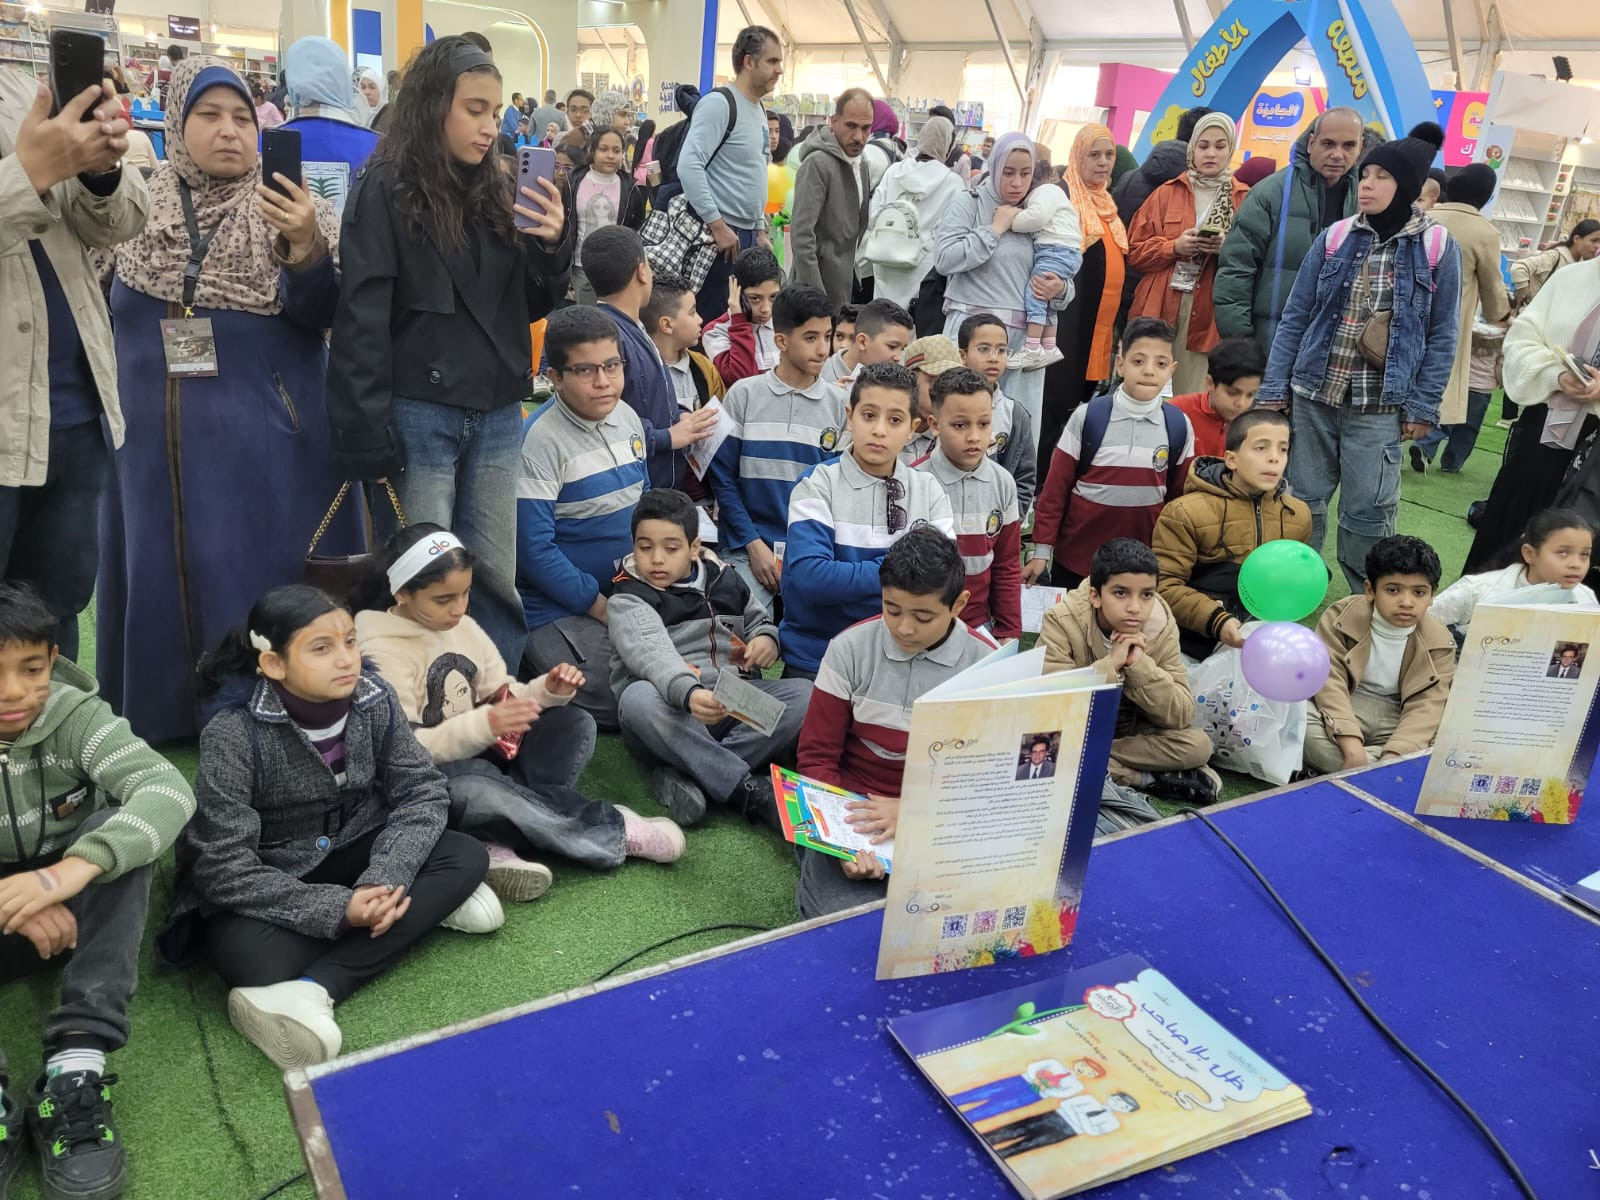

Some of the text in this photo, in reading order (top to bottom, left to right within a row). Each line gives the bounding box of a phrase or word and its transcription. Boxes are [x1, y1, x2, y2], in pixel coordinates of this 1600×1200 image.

[1191, 17, 1250, 97] الأطفال
[1140, 1003, 1189, 1045] صاحب
[1187, 1045, 1210, 1061] بلا
[1208, 1063, 1244, 1091] ظل
